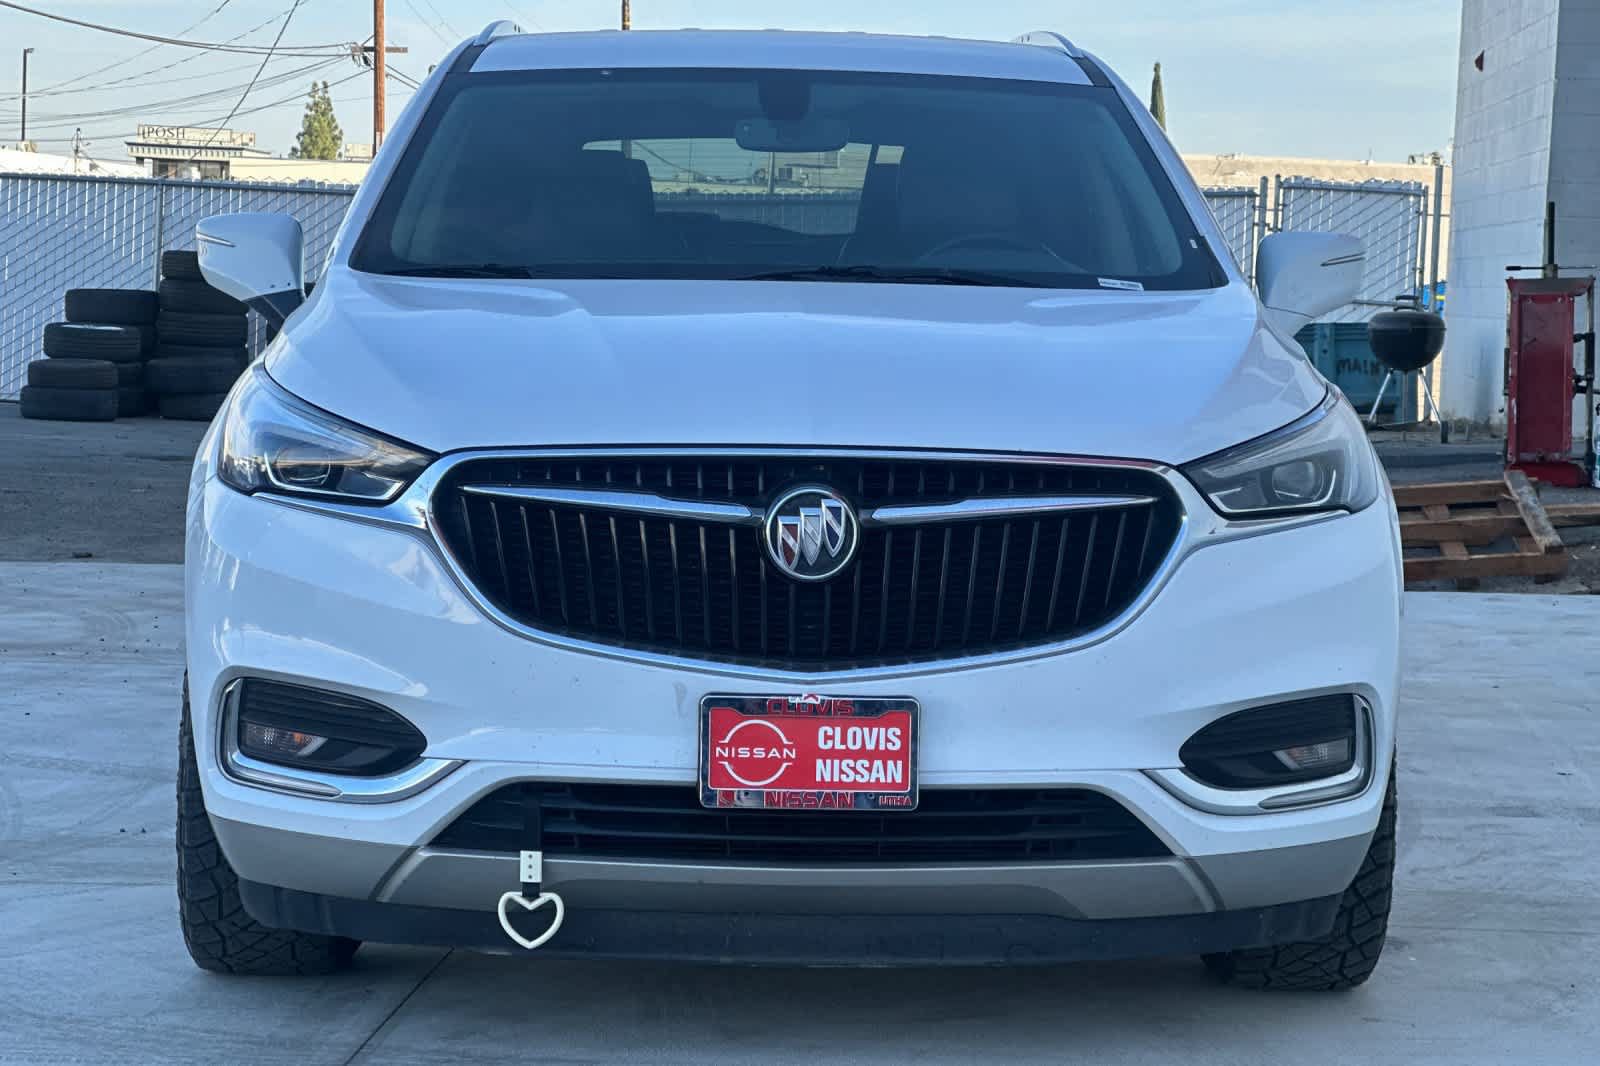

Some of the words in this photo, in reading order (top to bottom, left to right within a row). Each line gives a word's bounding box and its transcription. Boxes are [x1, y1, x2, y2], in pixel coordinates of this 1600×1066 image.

[147, 126, 185, 139] POSH
[767, 698, 854, 716] CLOVIS
[817, 726, 901, 751] CLOVIS
[715, 747, 796, 759] NISSAN
[815, 758, 902, 784] NISSAN
[763, 791, 854, 809] NISSAN
